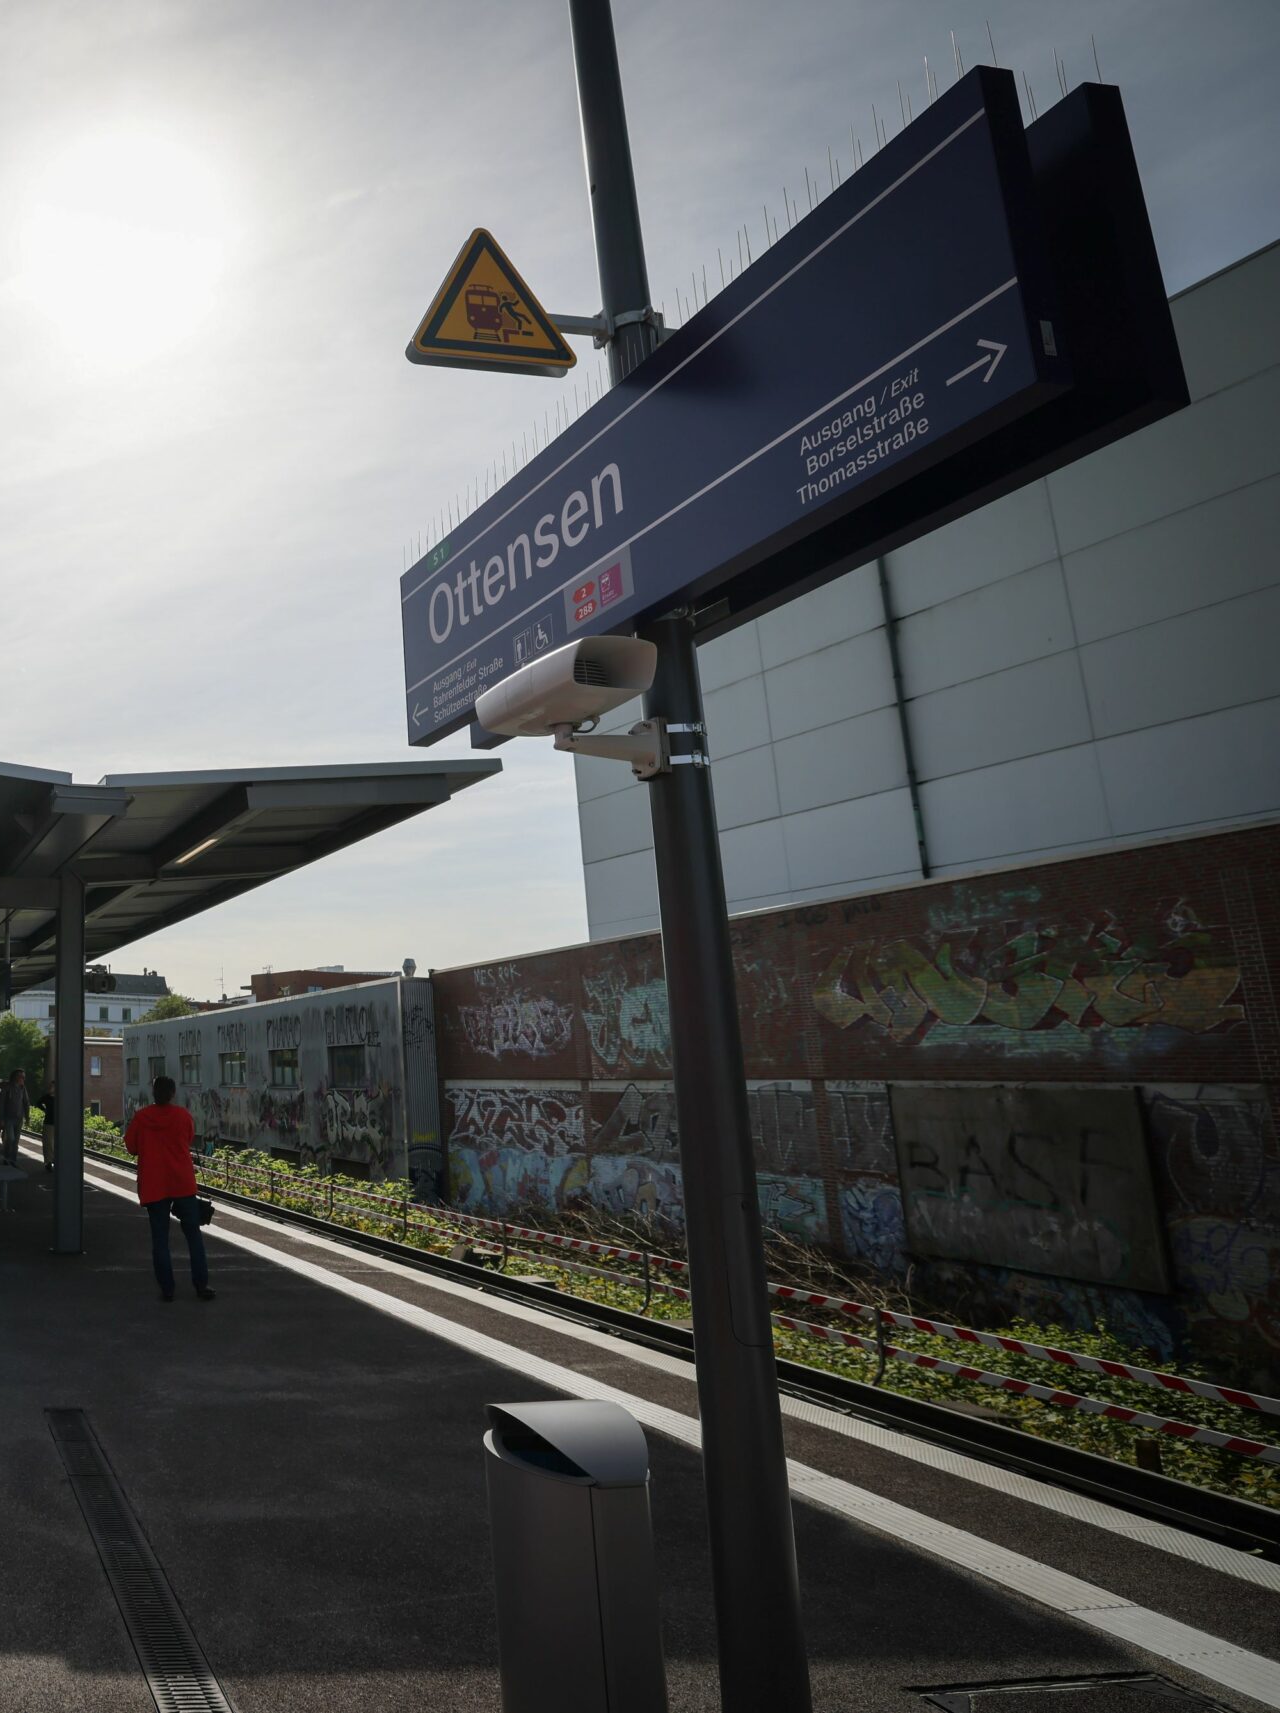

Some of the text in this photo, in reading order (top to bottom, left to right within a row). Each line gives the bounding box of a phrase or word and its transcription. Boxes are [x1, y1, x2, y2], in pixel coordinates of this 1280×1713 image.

[800, 395, 876, 456] Ausgang
[890, 367, 919, 398] Exit
[806, 391, 925, 476] Borselstraße
[796, 417, 929, 505] Thomasstraße
[429, 463, 624, 644] Ottensen
[579, 602, 593, 619] 288
[581, 587, 587, 599] 2
[433, 667, 462, 693] Ausgang
[433, 657, 504, 708] Bahrenfelder Straße
